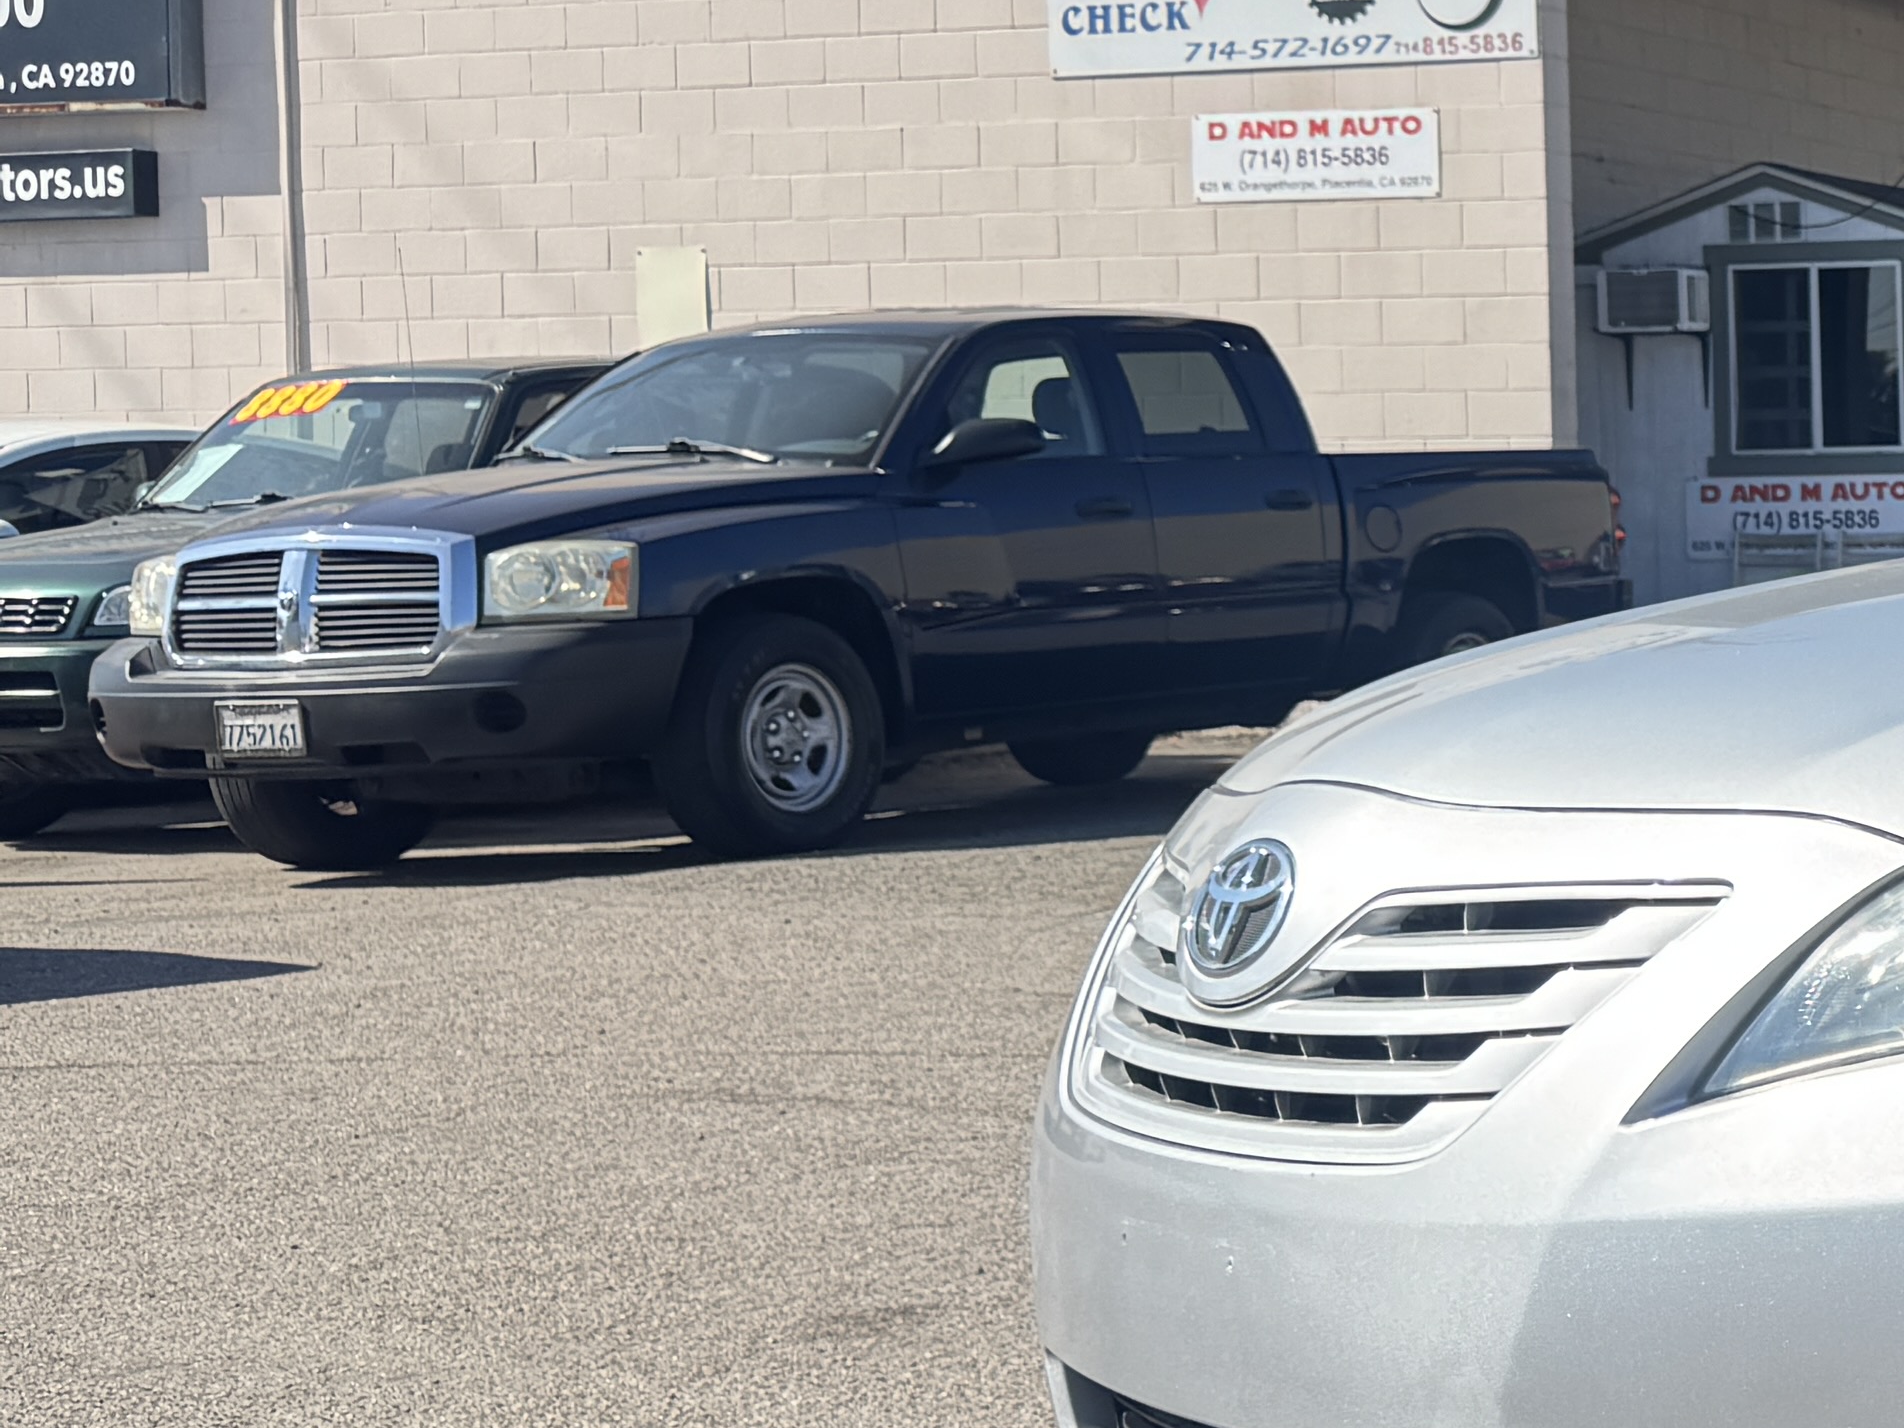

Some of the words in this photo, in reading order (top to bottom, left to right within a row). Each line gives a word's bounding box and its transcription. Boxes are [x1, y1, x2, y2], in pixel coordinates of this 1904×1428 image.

[1062, 1, 1191, 35] CHECK
[1184, 34, 1392, 63] 714-572-1697
[21, 64, 57, 90] CA
[59, 60, 136, 88] 92870
[1207, 122, 1228, 141] D
[1238, 120, 1299, 140] AND
[1308, 118, 1331, 138] M
[1340, 115, 1423, 136] AUTO
[1240, 148, 1290, 174] (714)
[1296, 146, 1390, 168] 815-5836
[1700, 485, 1722, 504] D
[1730, 483, 1792, 503] AND
[1800, 483, 1822, 502] M
[1733, 510, 1782, 533] (714)
[1788, 508, 1880, 530] 815-5836
